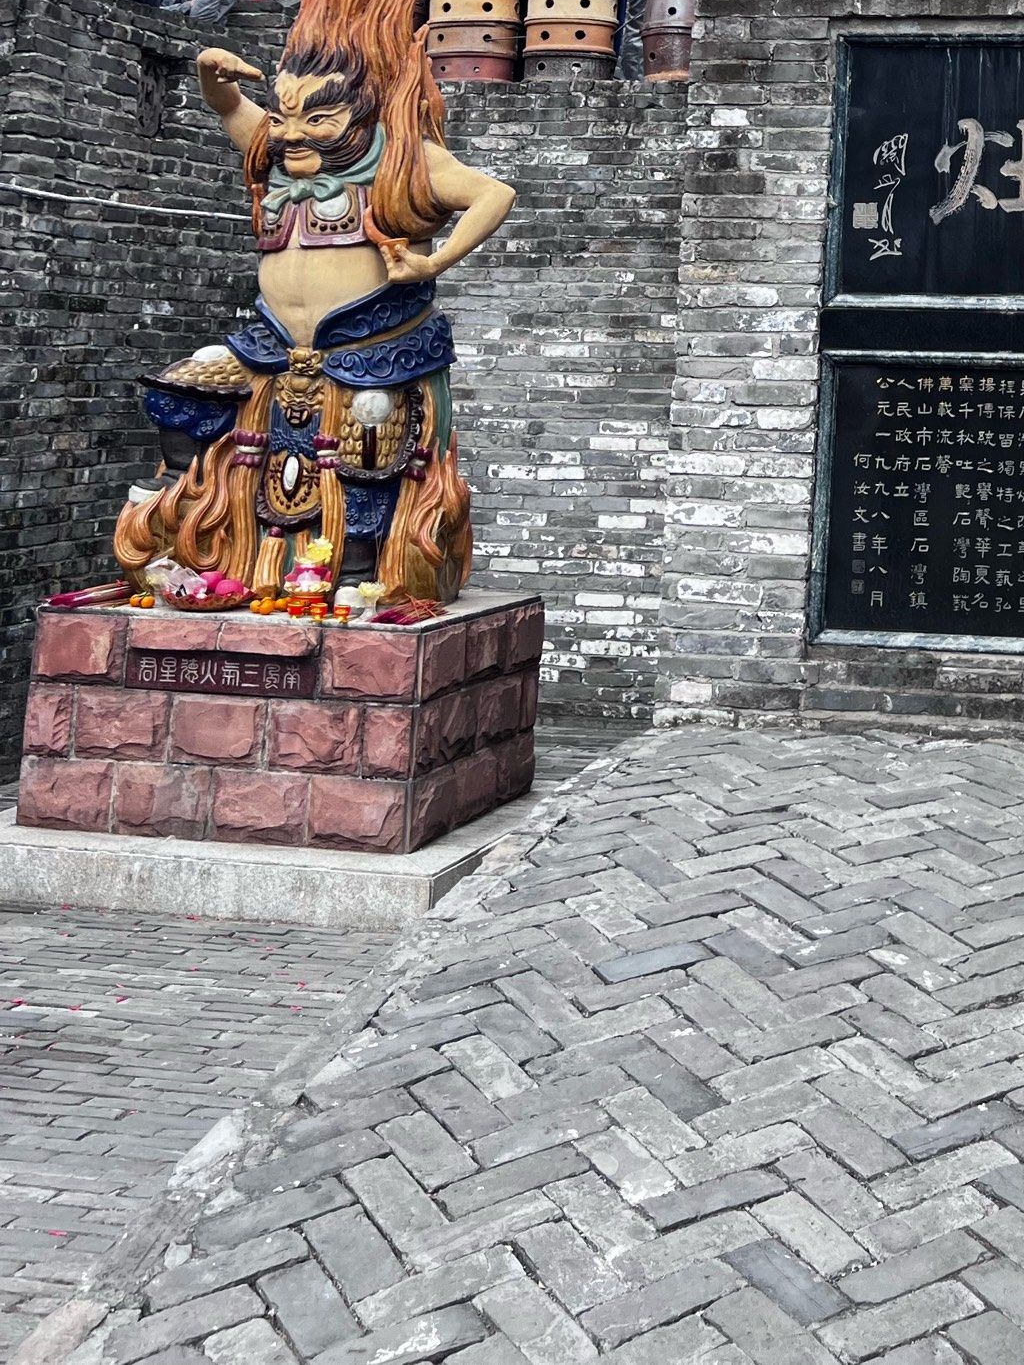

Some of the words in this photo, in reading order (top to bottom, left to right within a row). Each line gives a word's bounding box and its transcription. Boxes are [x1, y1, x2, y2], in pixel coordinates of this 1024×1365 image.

[852, 453, 870, 552] 何汝文書
[869, 377, 894, 607] 公元一九九八年八月
[892, 378, 915, 497] 人民政府立
[908, 377, 933, 608] 佛山市石灣區石灣鎮
